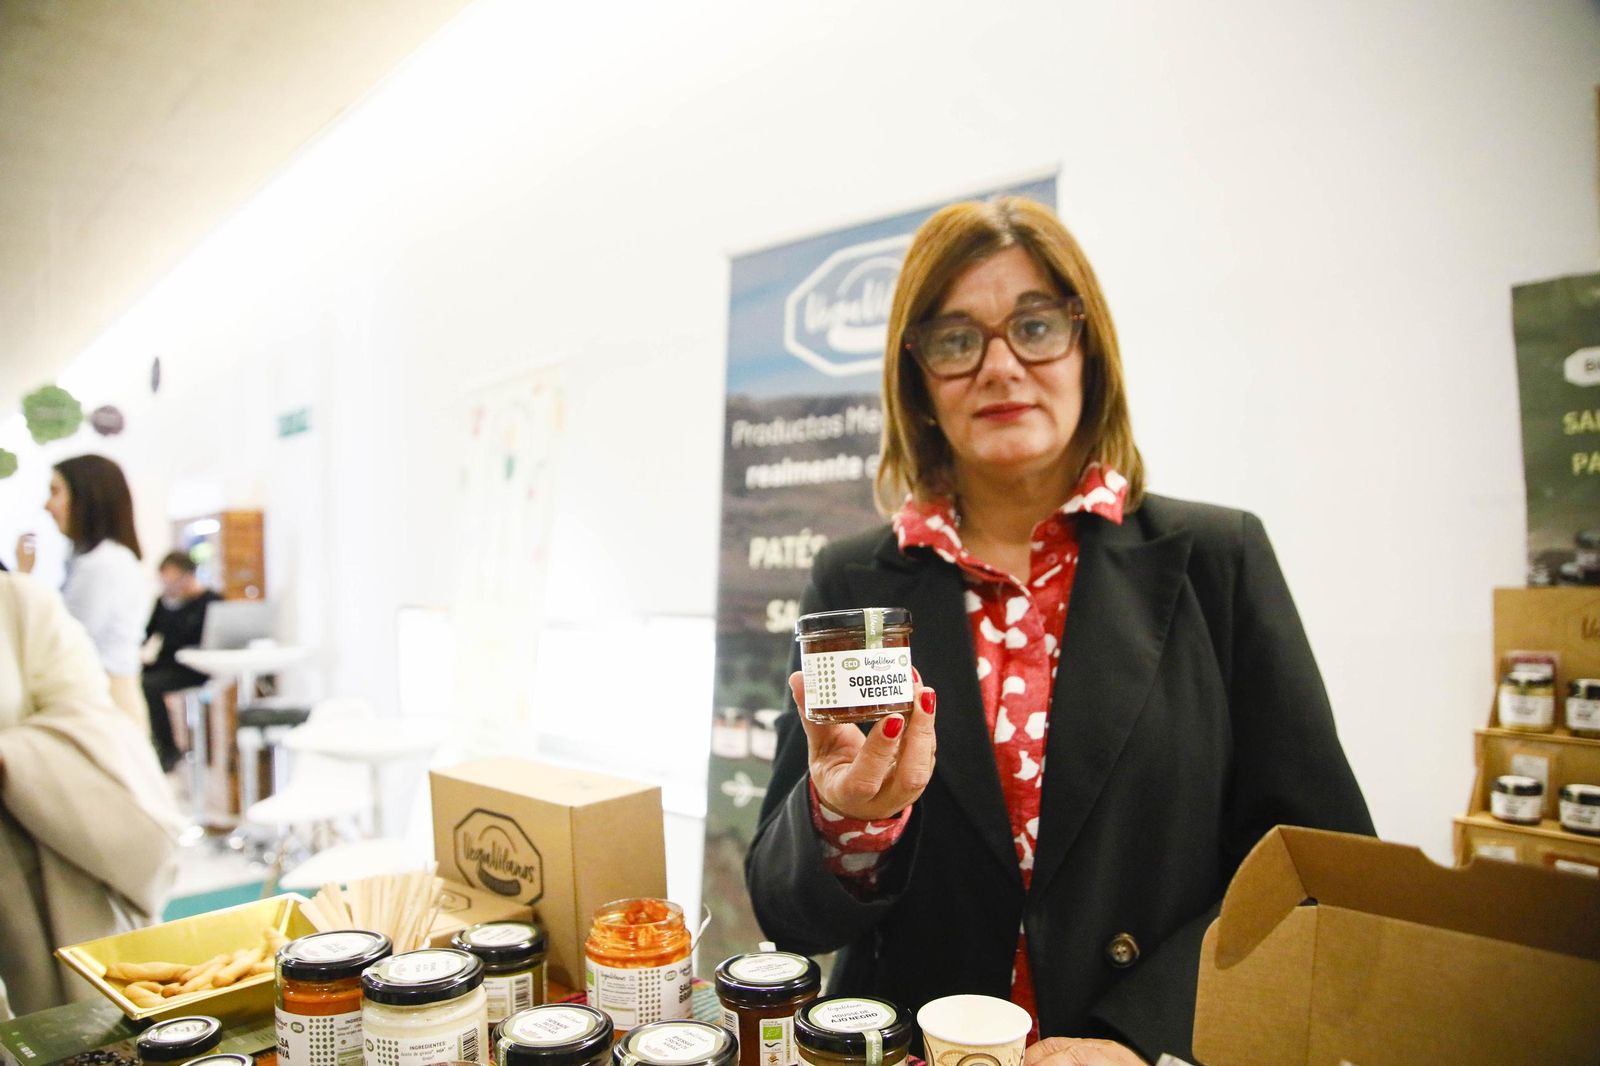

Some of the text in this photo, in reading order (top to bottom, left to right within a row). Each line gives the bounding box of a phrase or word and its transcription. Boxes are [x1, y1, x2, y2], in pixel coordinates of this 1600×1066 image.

[731, 409, 844, 449] Productos
[746, 453, 863, 489] realmente
[848, 672, 908, 688] SOBRASADA
[859, 685, 904, 698] VEGETAL
[831, 1010, 859, 1019] MOUSSE
[831, 1012, 878, 1024] AJO NEGRO
